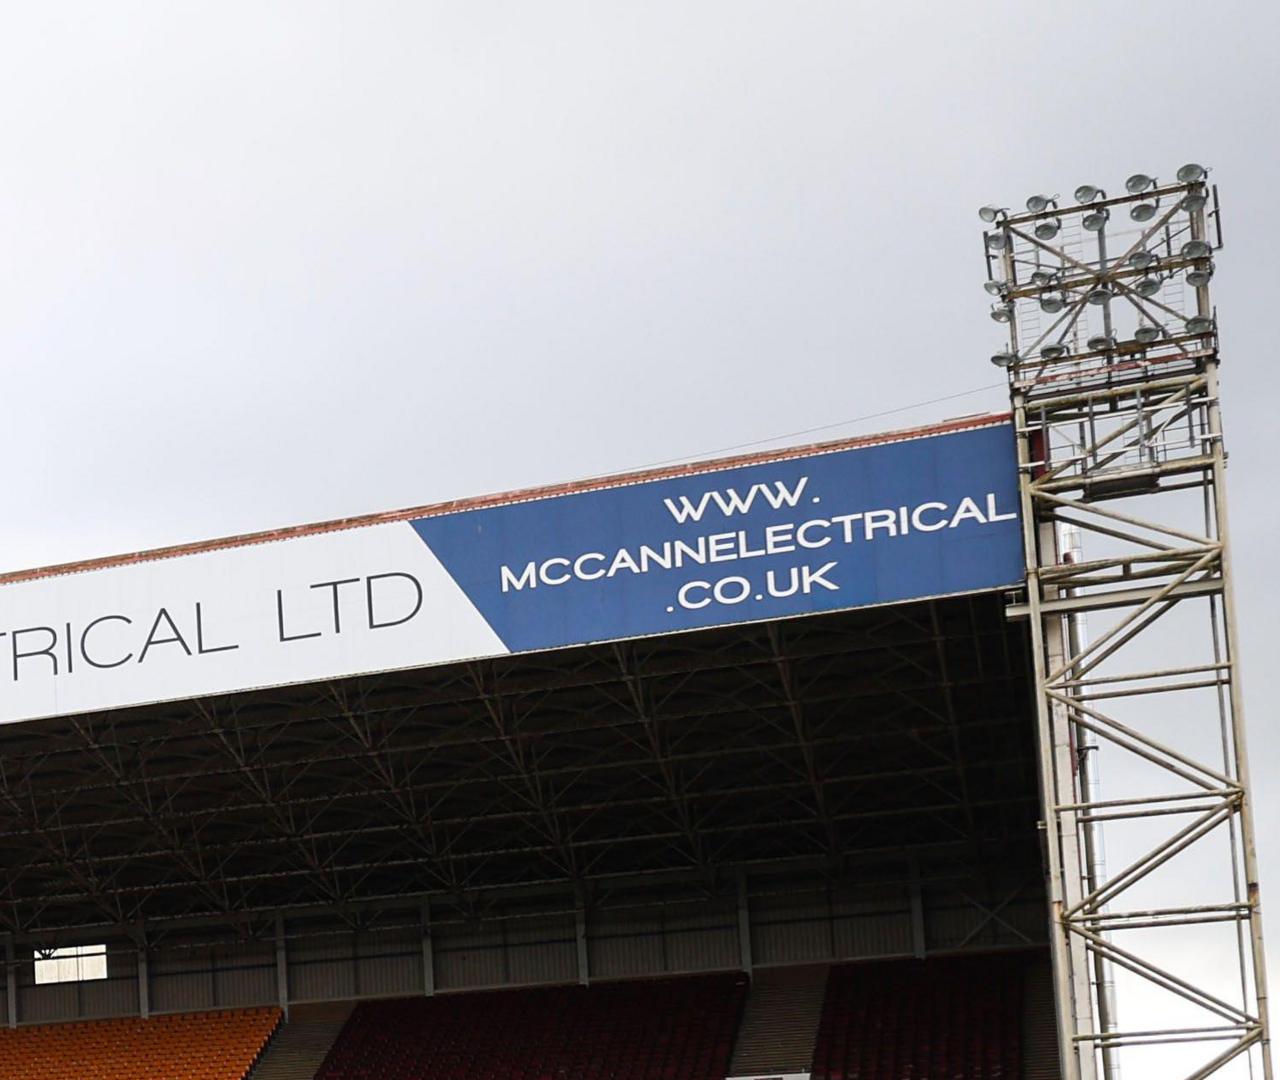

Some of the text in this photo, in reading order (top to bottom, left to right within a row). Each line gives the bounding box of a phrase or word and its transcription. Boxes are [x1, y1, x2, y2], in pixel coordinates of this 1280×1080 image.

[664, 477, 821, 524] WWW.
[500, 493, 1018, 592] MCCANNELECTRICAL
[276, 571, 423, 644] LTD
[666, 562, 840, 613] .CO.UK
